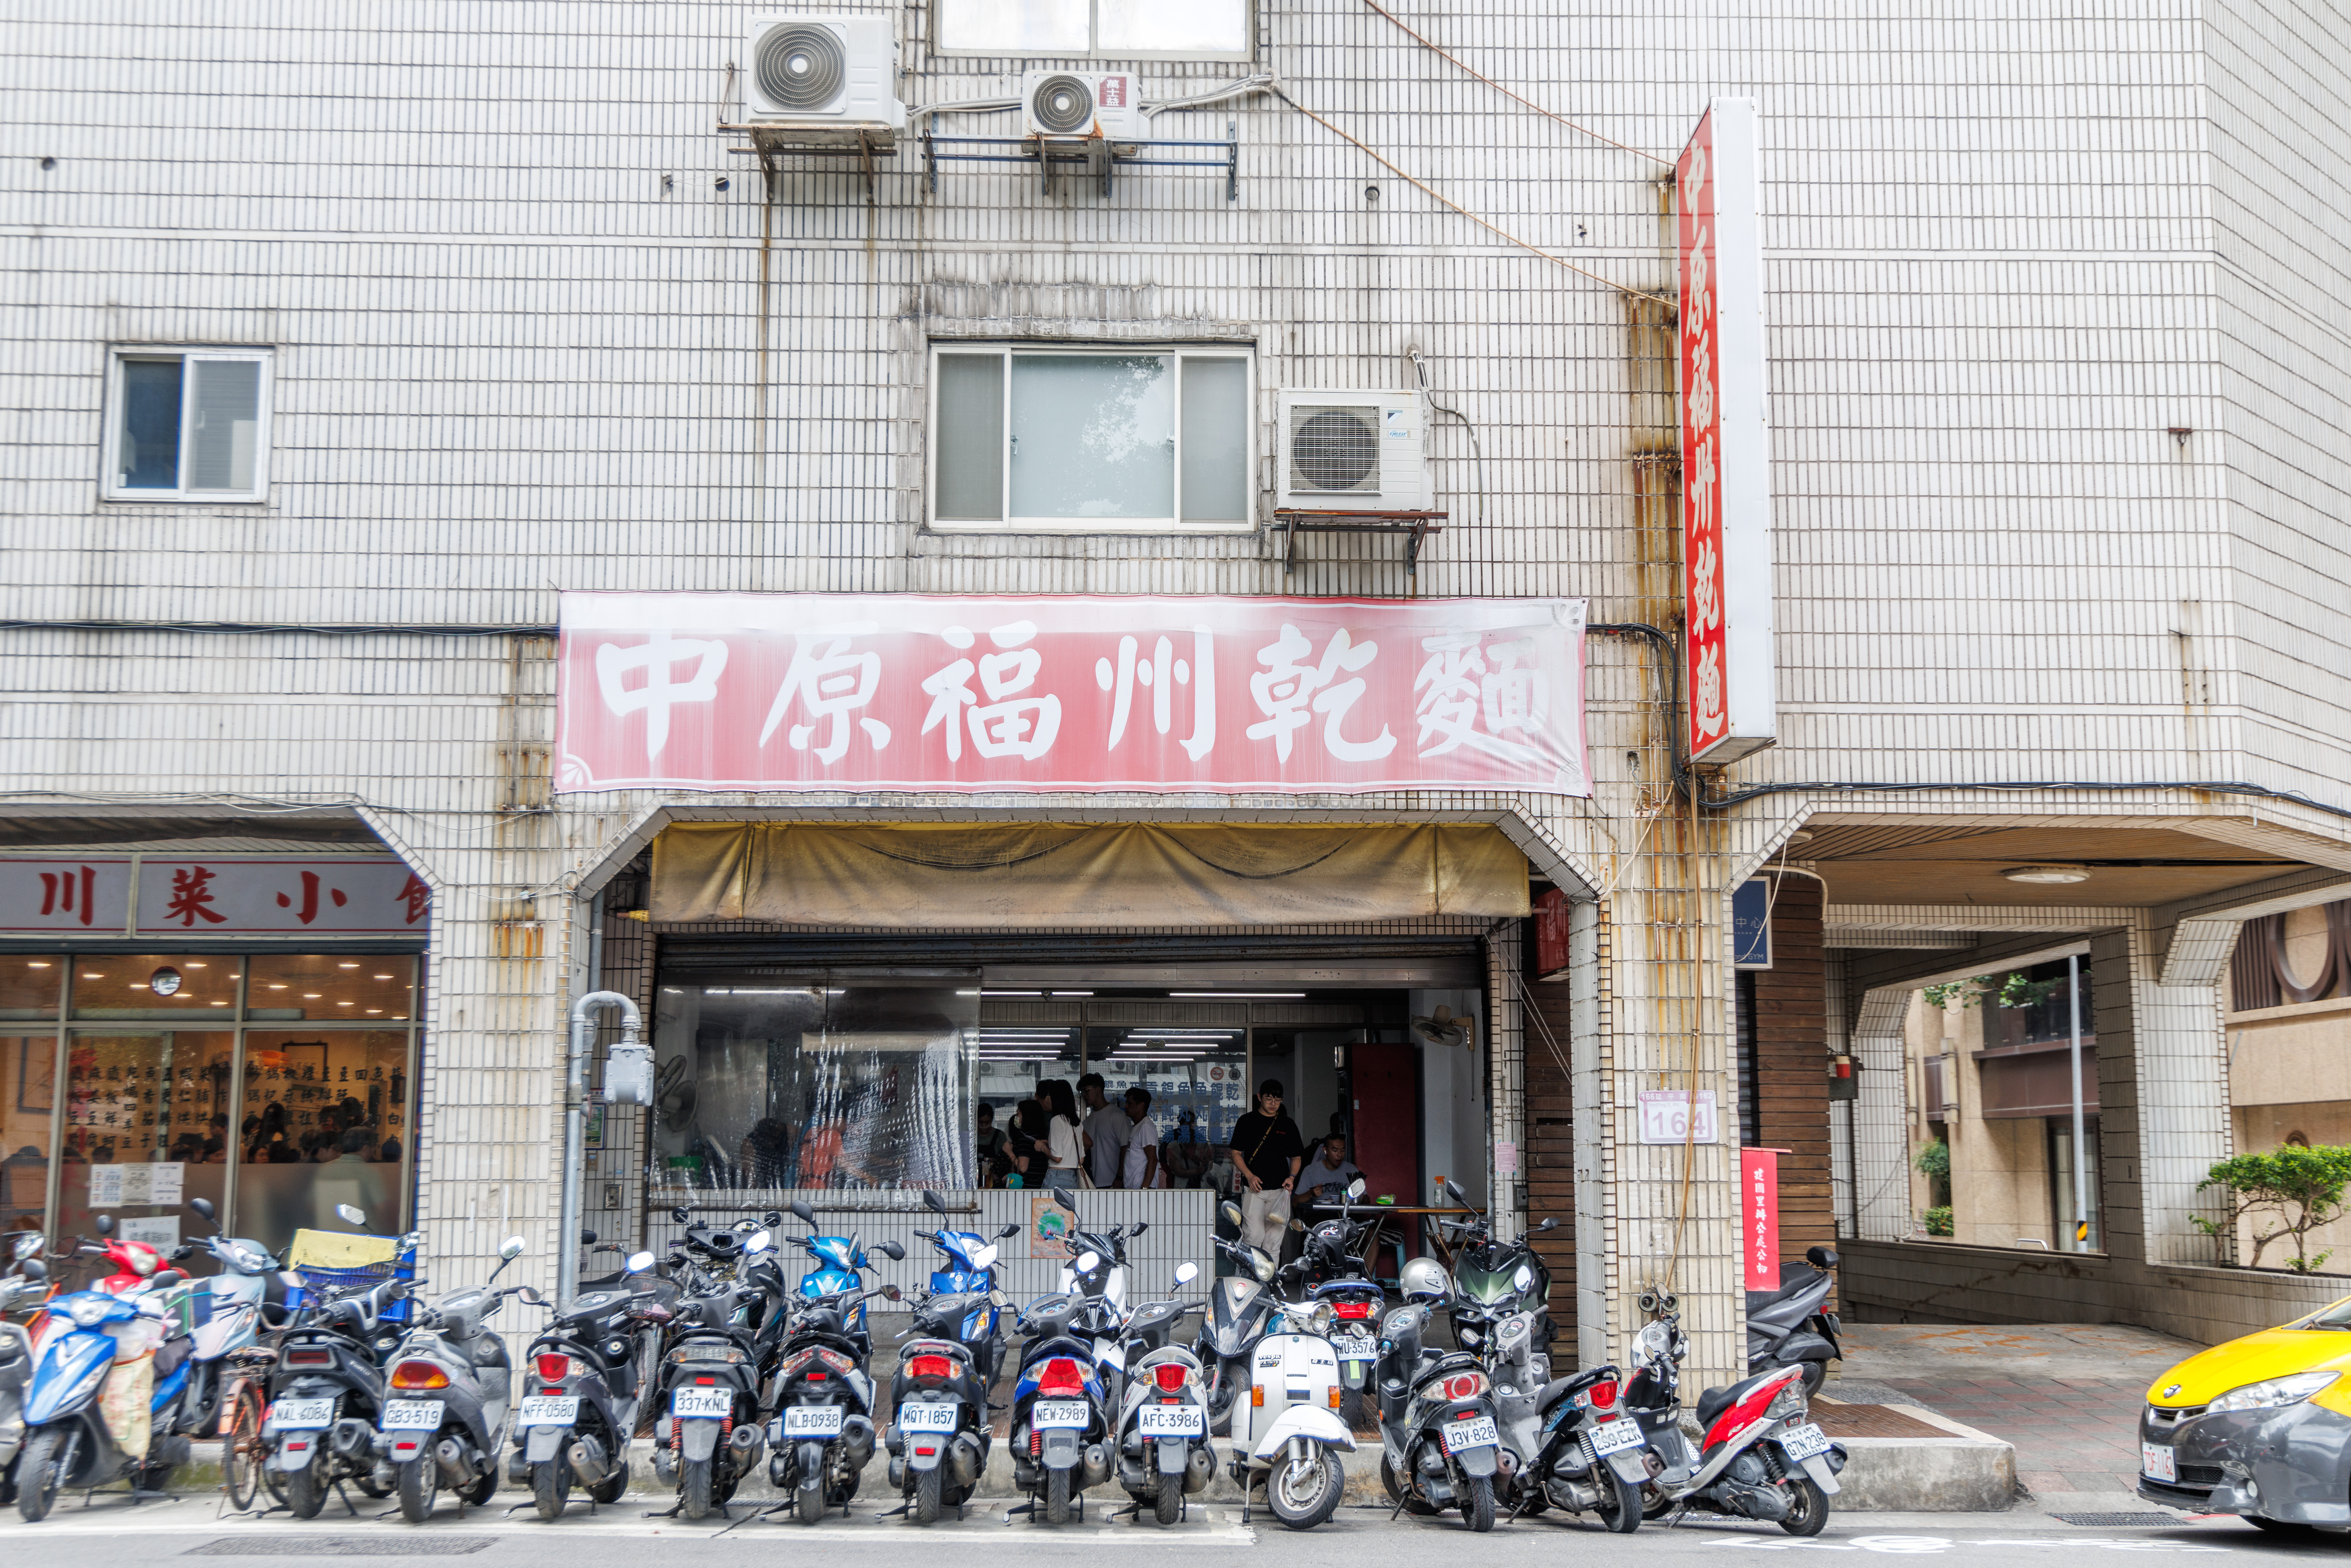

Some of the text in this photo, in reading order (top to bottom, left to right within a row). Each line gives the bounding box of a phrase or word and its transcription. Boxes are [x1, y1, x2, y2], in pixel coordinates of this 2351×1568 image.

[1106, 79, 1119, 106] 萬士益
[1684, 138, 1724, 743] 中原福州乾麵
[596, 620, 1549, 765] 中原福州乾麵
[1653, 1111, 1706, 1135] 164
[1336, 1342, 1375, 1354] WU-3576
